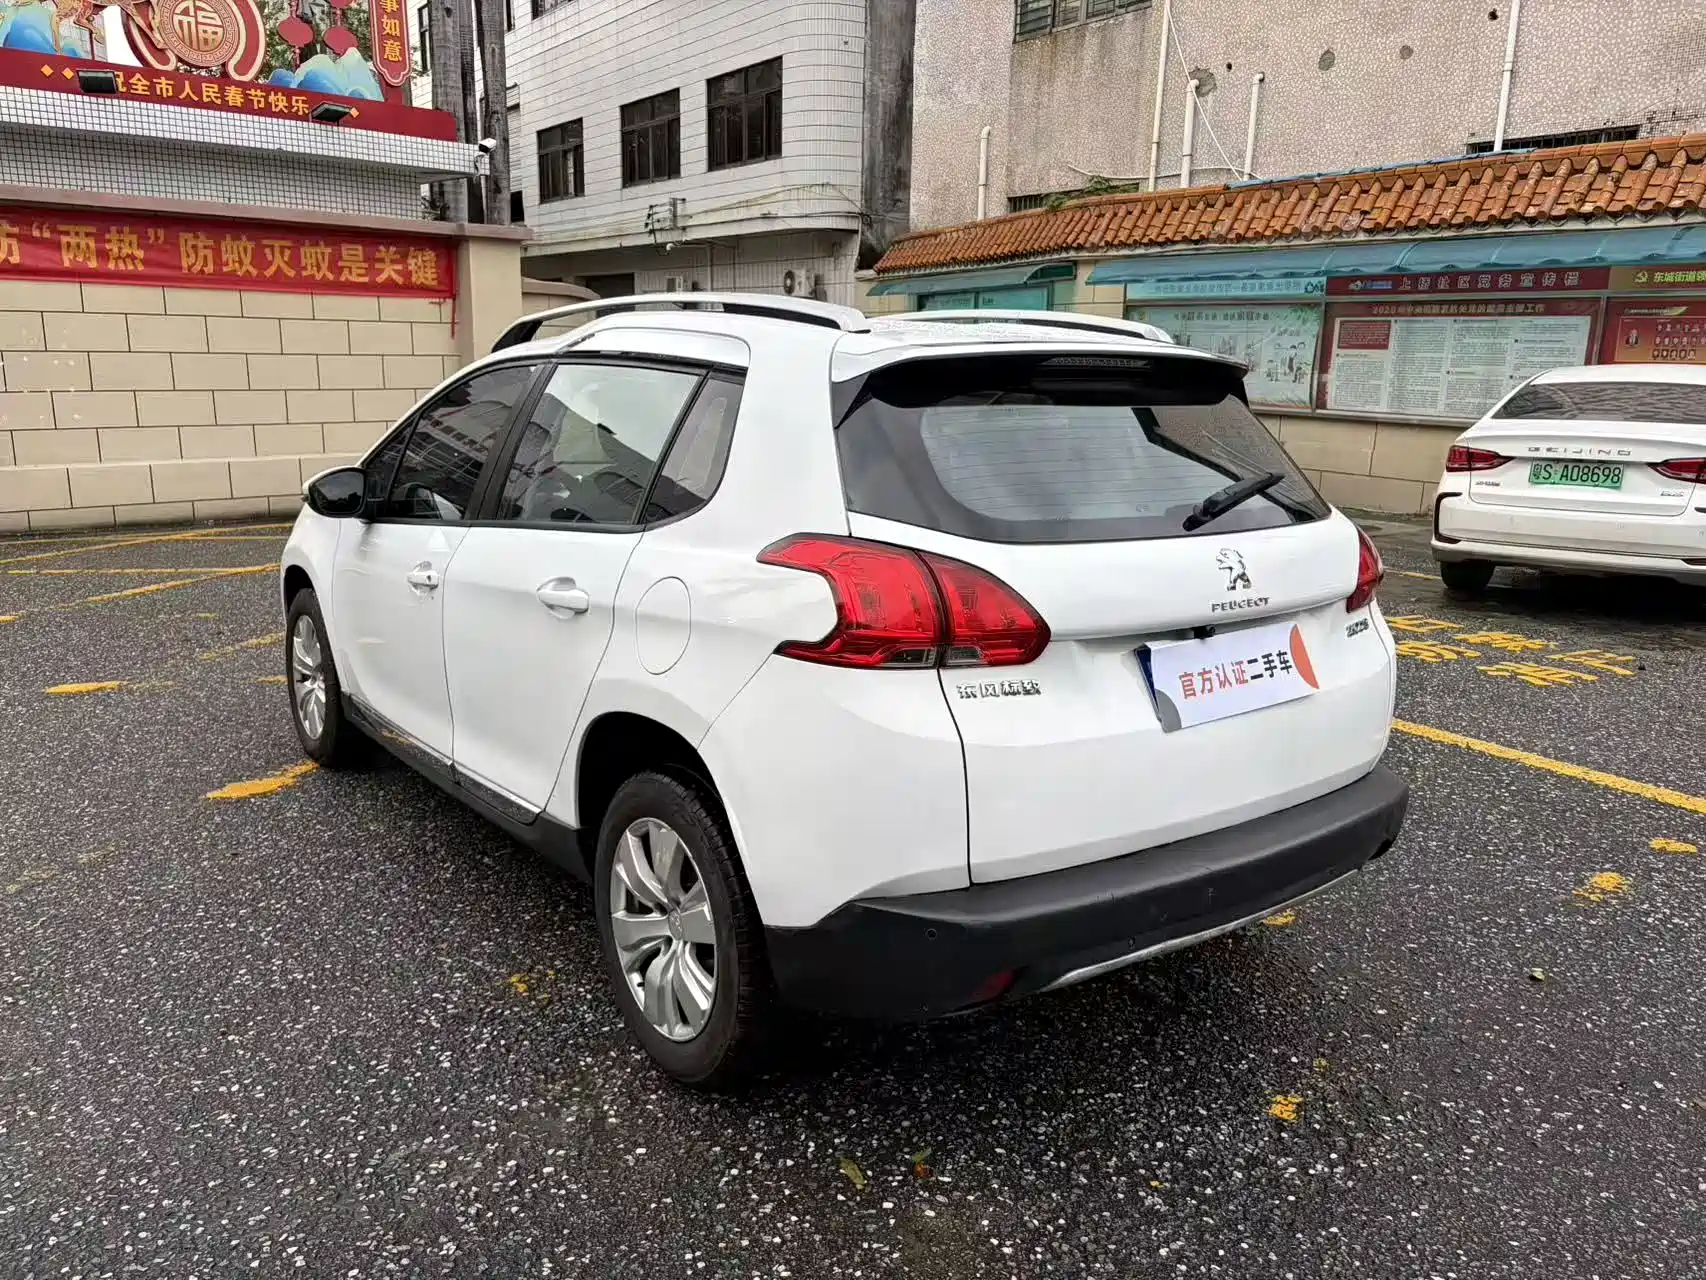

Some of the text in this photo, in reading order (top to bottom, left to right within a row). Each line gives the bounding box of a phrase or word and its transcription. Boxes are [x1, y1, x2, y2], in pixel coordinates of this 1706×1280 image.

[172, 0, 226, 51] 福
[1528, 446, 1632, 457] BEIJING
[1211, 597, 1270, 613] PEUGEOT
[1178, 649, 1293, 700] 官方认证二手车
[956, 679, 1042, 699] 东风标致
